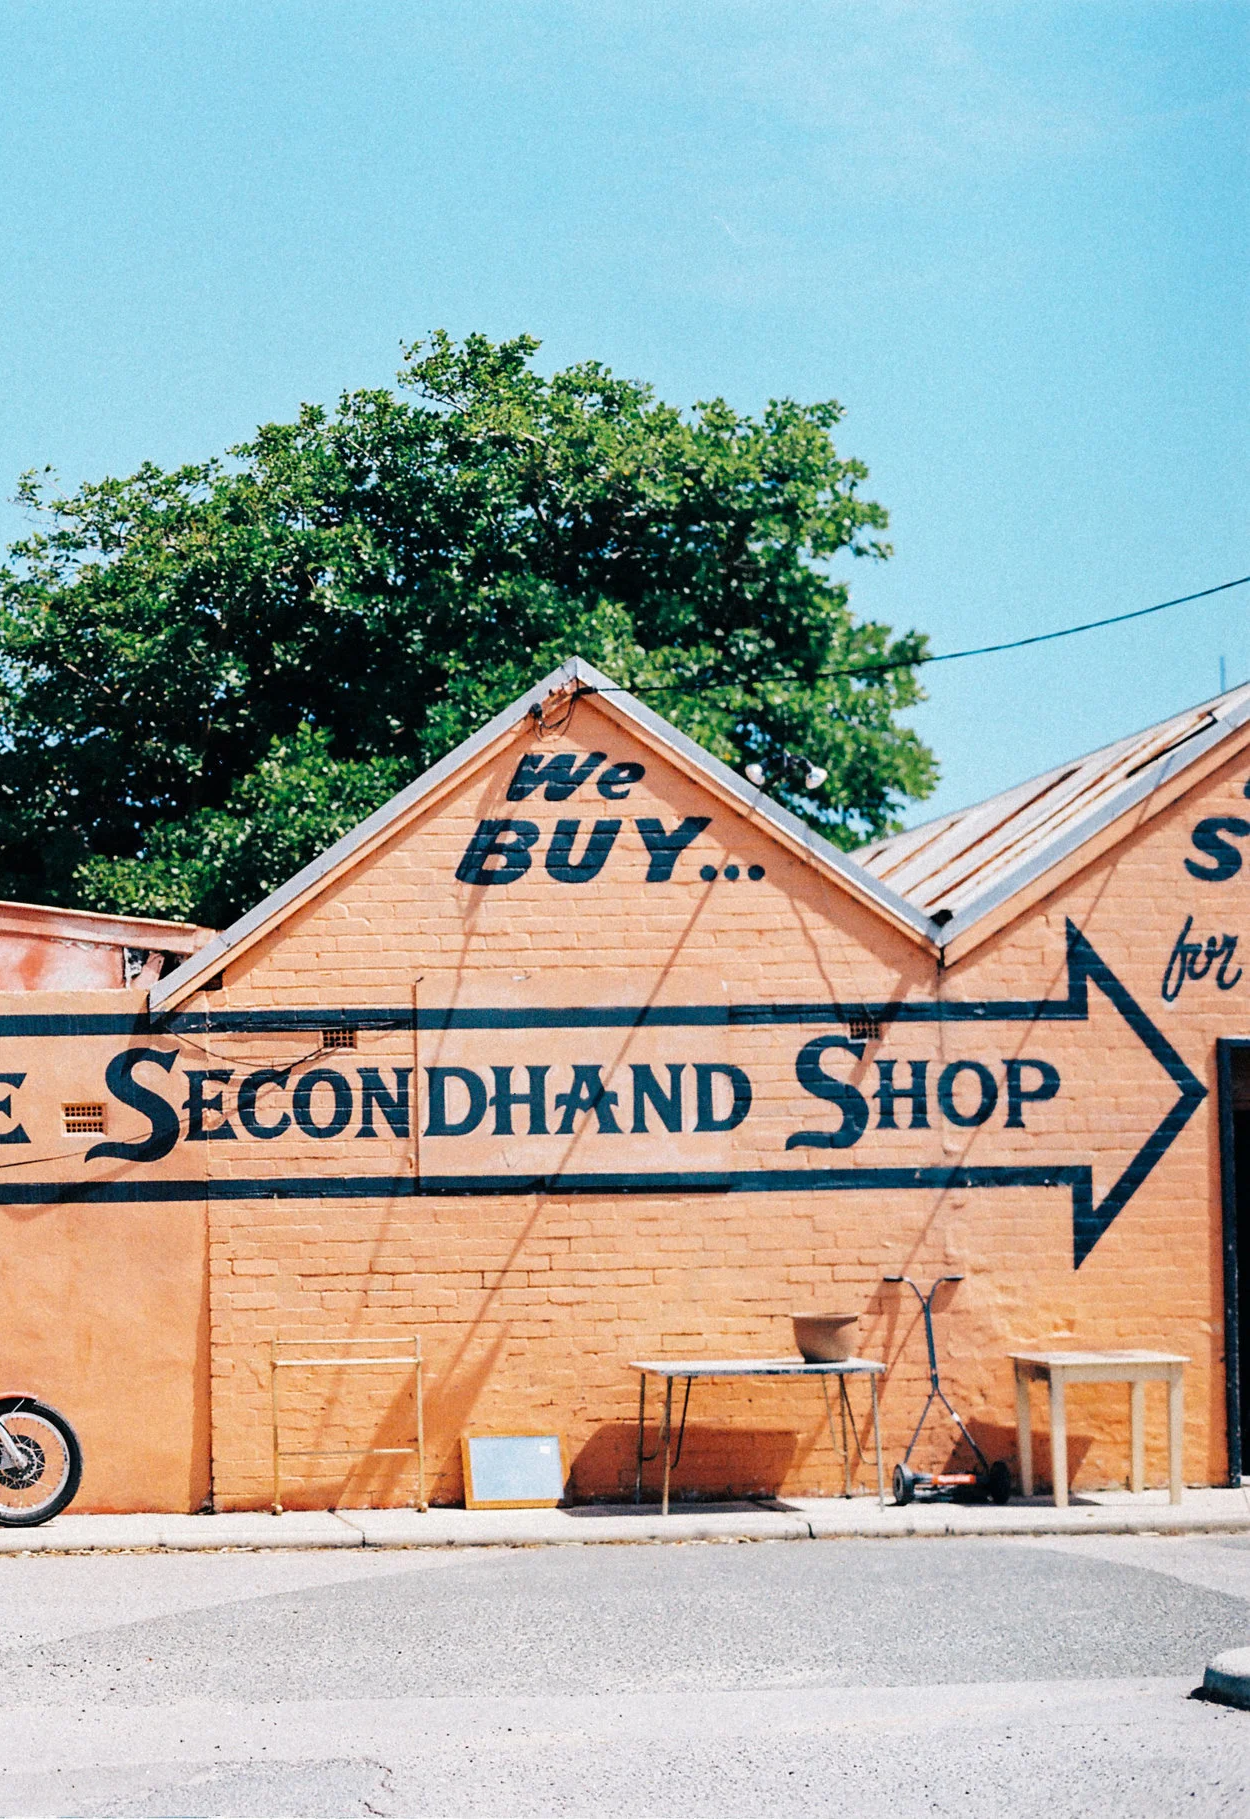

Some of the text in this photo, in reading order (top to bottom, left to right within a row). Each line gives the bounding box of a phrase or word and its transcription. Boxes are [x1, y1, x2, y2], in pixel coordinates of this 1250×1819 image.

[505, 751, 646, 802] We
[454, 816, 766, 886] BUY...
[1161, 915, 1243, 1003] for
[84, 1047, 753, 1163] SECONDHAND
[784, 1034, 1062, 1151] SHOP
